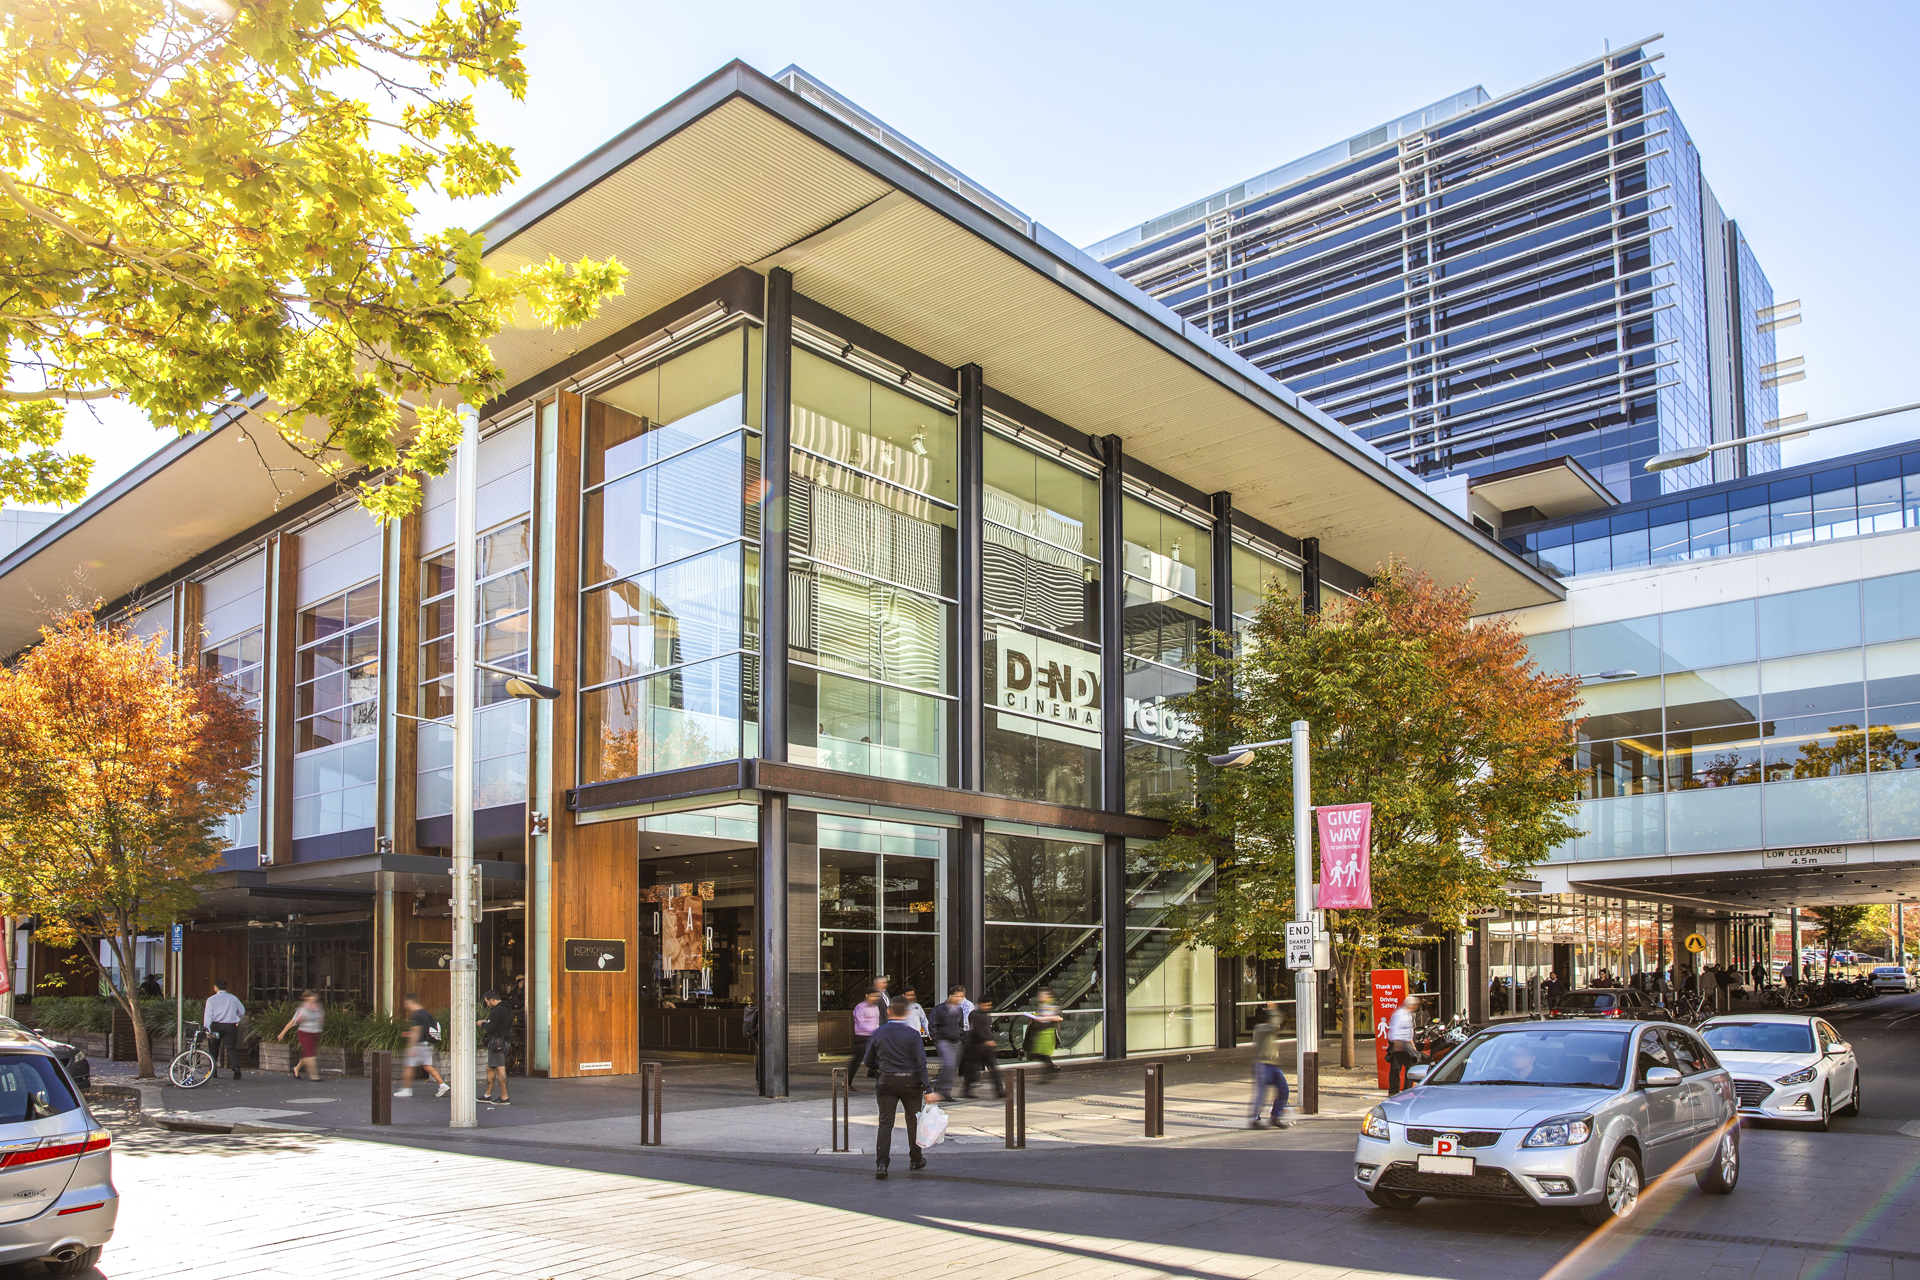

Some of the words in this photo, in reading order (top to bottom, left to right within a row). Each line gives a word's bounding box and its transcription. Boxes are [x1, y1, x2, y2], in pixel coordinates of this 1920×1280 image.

[1006, 648, 1101, 709] DENDY
[857, 781, 880, 797] and
[1328, 810, 1362, 825] GIVE
[1330, 827, 1361, 842] WAY
[1788, 846, 1842, 857] CLEARANCE
[1289, 926, 1310, 936] END
[1437, 1141, 1452, 1155] P
